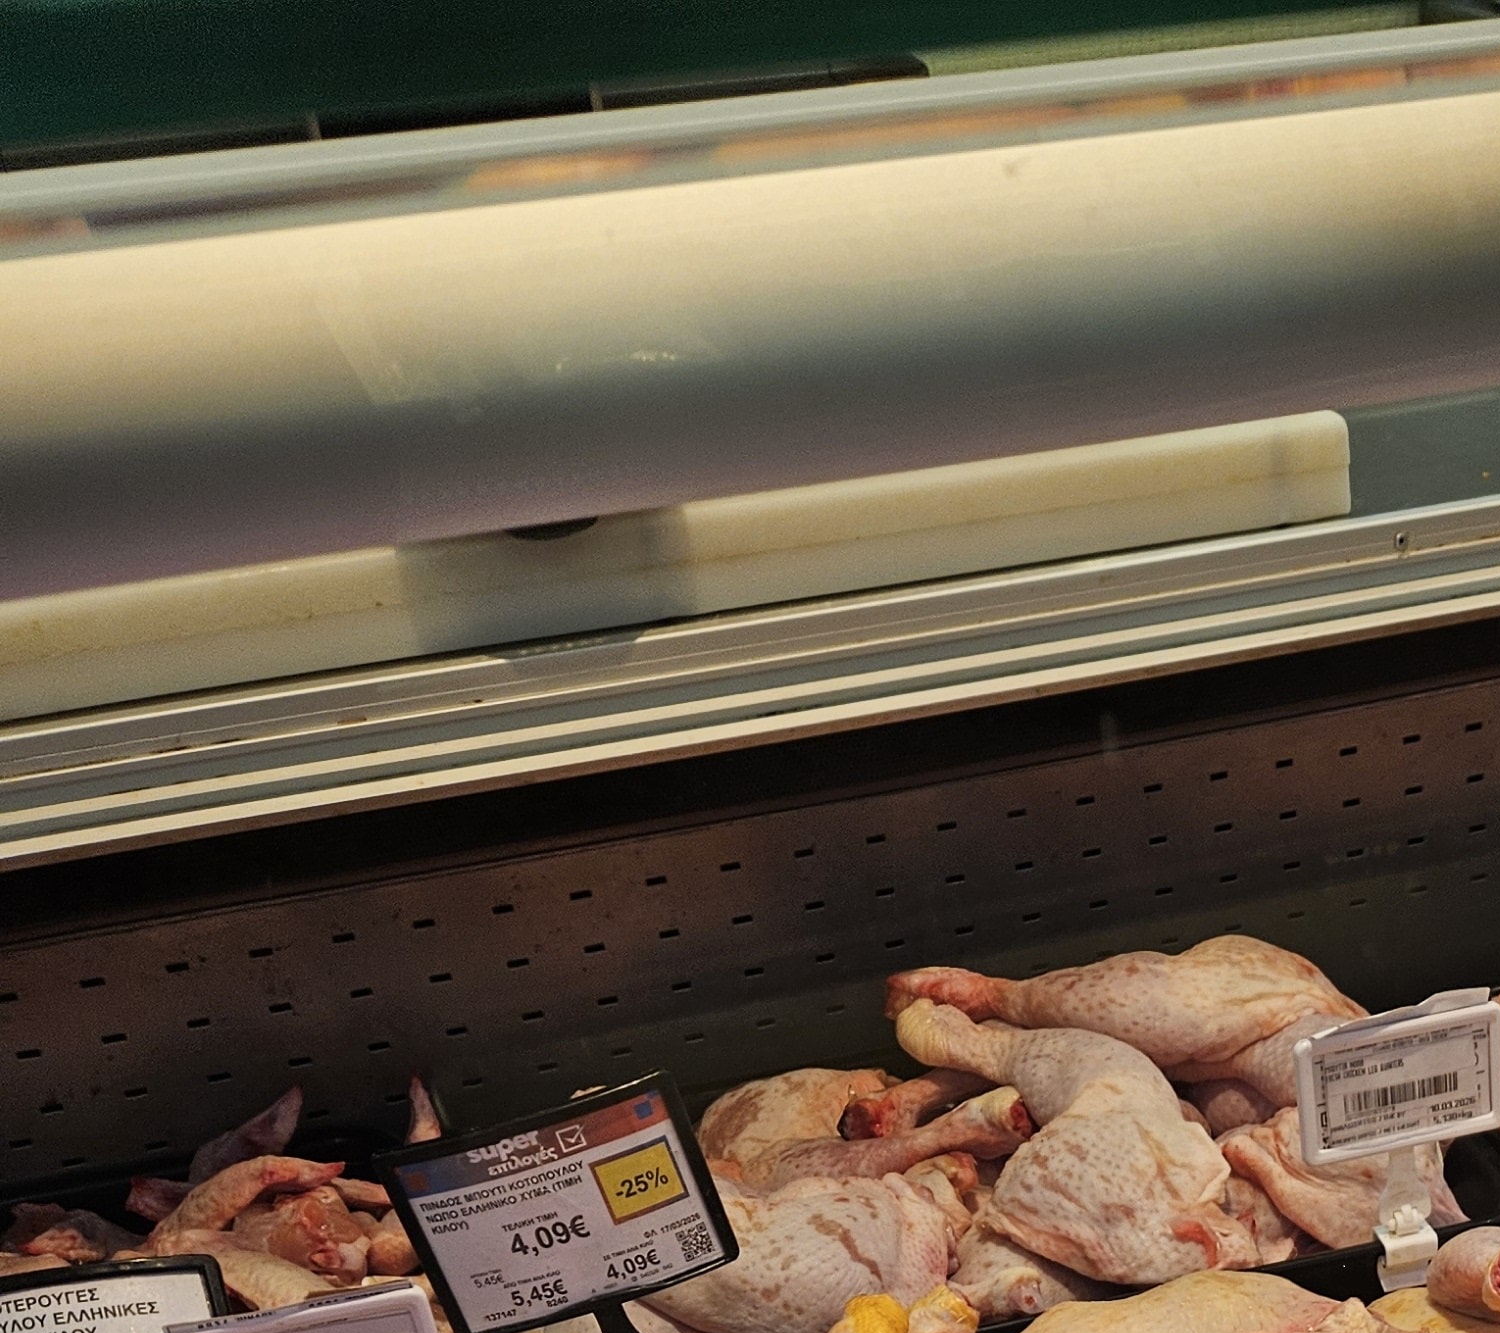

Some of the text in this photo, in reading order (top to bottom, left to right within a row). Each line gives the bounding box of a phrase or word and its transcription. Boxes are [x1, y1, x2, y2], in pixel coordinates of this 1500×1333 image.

[466, 1130, 542, 1163] super
[488, 1146, 560, 1177] επιλογές
[419, 1160, 584, 1214] ΠΙΝΔΟΣ ΜΠΟΥΤΙ ΚΟΤΟΠΟΥΛΟΥ
[615, 1166, 669, 1200] -25%
[425, 1174, 583, 1224] ΝΩΠΟ ΕΛΛΗΝΙΚΟ ΧΥΜΑ (ΤΙΜΗ
[431, 1220, 470, 1235] ΚΙΛΟΥ)
[501, 1211, 558, 1233] ΤΕΛΙΚΗ ΤΙΜΗ
[510, 1214, 590, 1256] 4,09€
[660, 1212, 701, 1234] 17/03/2026
[606, 1249, 661, 1280] 4,09€
[511, 1279, 568, 1307] 5,45€
[53, 1301, 160, 1326] ΕΛΛΗΝΙΚΕΣ
[484, 1308, 517, 1322] 137147
